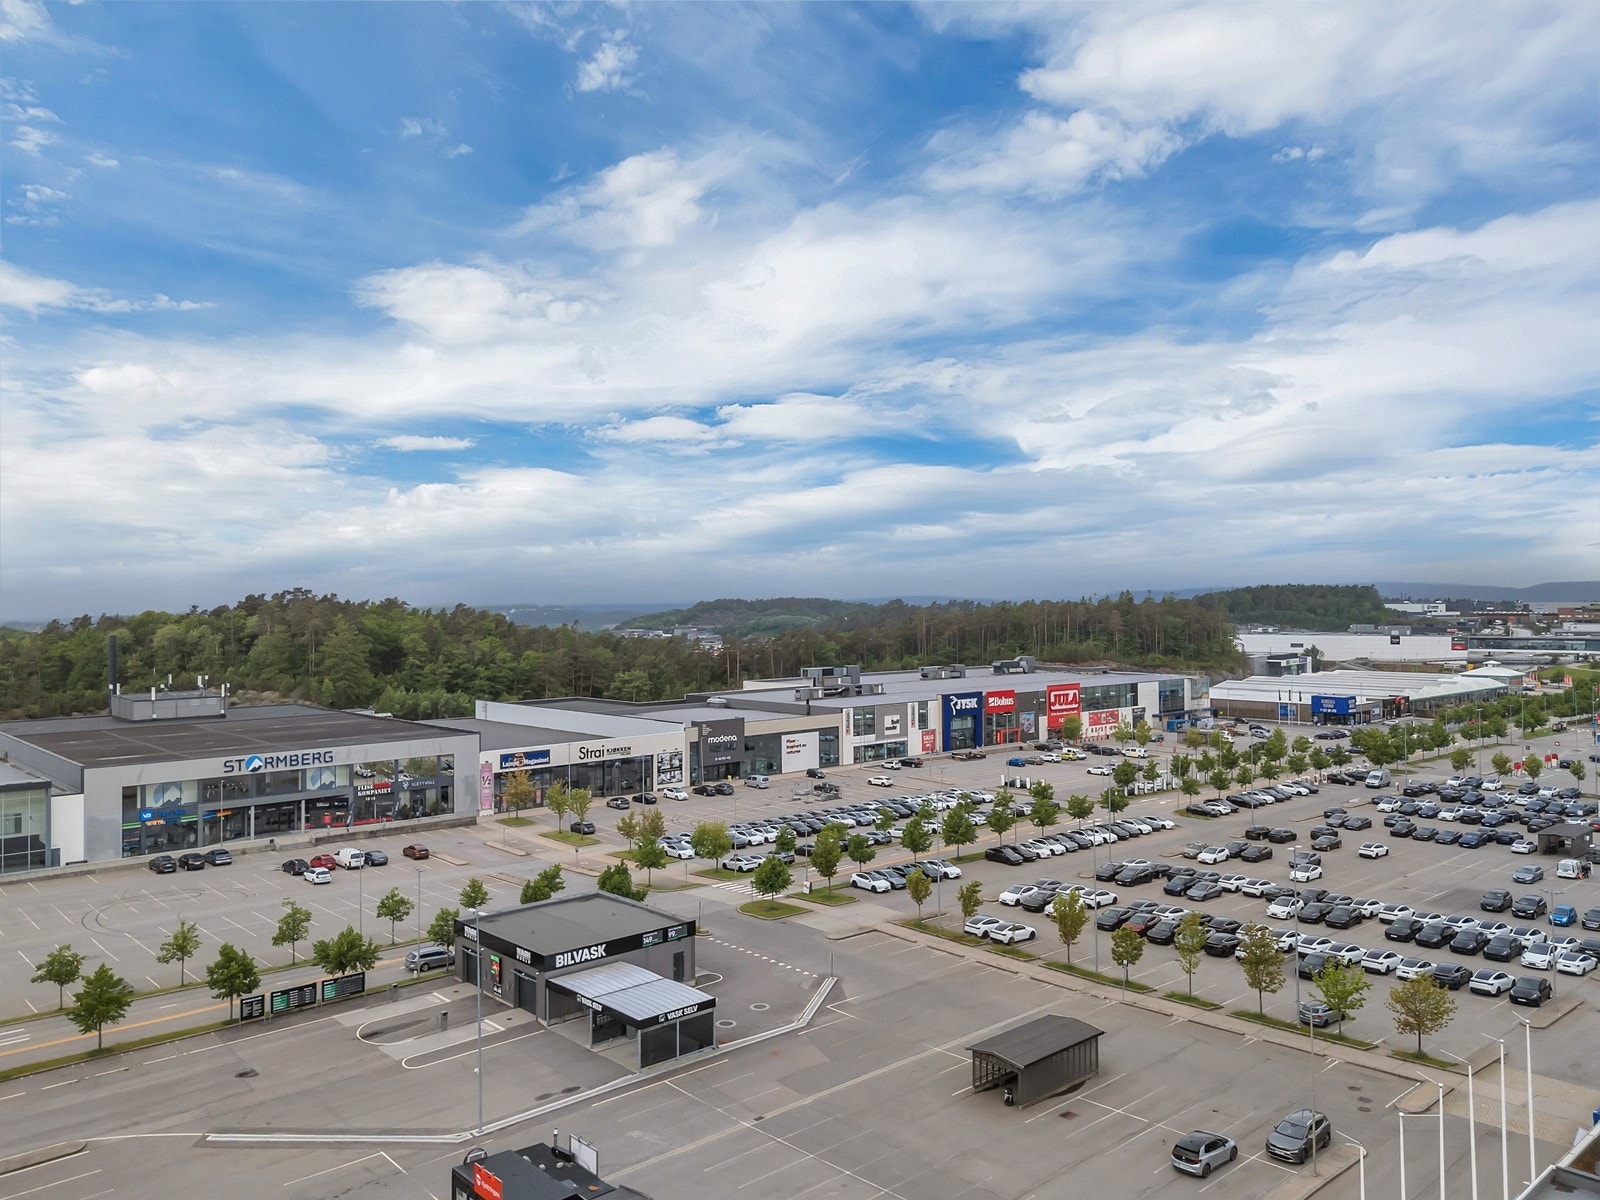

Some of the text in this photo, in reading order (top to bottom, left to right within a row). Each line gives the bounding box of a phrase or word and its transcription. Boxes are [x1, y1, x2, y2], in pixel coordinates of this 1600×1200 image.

[956, 698, 978, 709] JYSK
[994, 696, 1014, 706] Bohus
[1050, 692, 1079, 707] JULA
[708, 735, 737, 744] modena
[578, 744, 605, 760] Strai
[357, 787, 391, 797] KOMPANIET
[555, 943, 607, 969] BILVASK
[667, 1004, 699, 1020] VASK SELV
